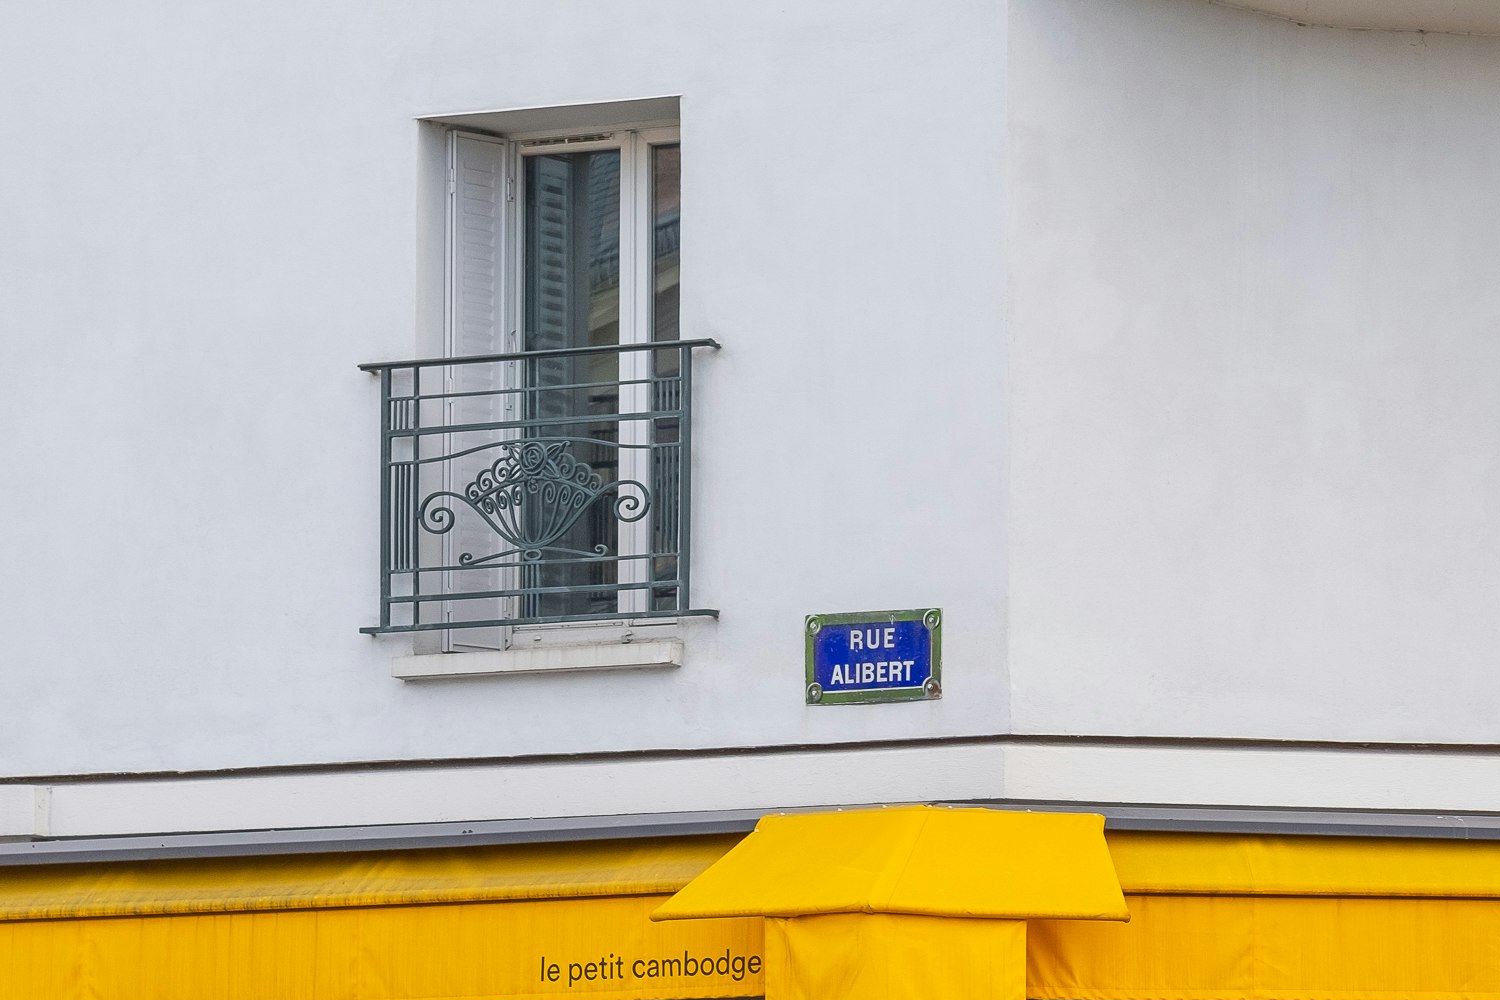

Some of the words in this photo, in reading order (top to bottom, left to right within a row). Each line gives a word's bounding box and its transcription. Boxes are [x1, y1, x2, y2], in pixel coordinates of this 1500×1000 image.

[850, 628, 896, 650] RUE
[830, 660, 915, 685] ALIBERT
[541, 956, 561, 982] le
[568, 953, 624, 987] petit
[632, 949, 762, 982] cambodge
